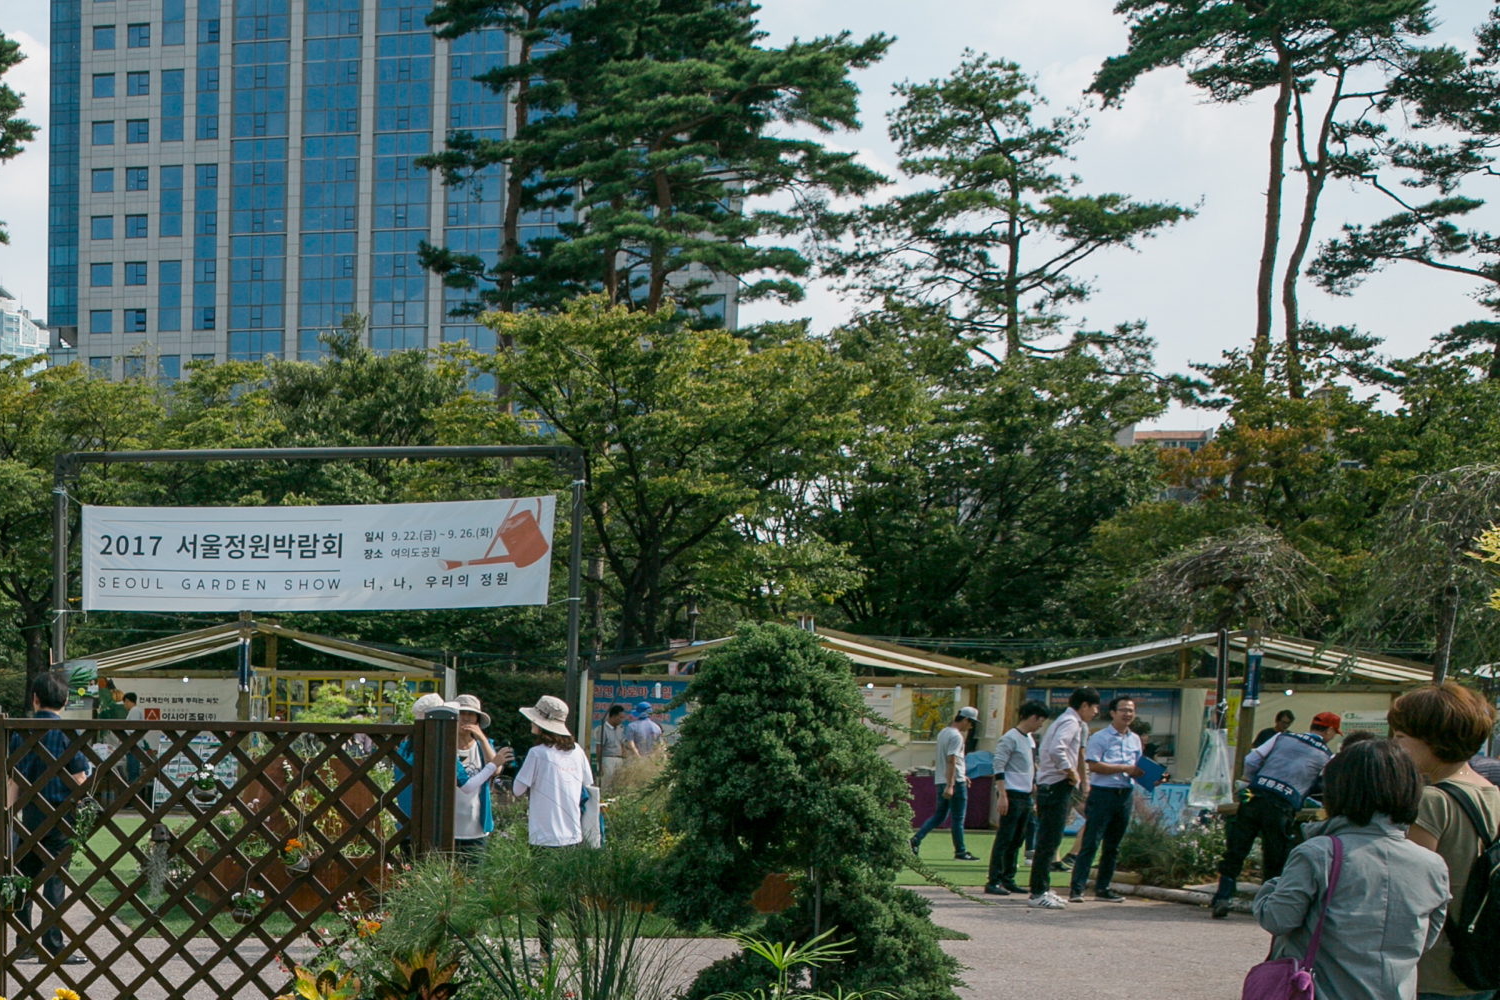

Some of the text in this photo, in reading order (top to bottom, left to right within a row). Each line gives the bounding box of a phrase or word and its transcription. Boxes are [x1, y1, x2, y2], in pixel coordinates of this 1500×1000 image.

[364, 531, 384, 543] 일시
[391, 531, 401, 542] 9.
[403, 529, 437, 542] 22.(금)
[447, 529, 457, 539] 9.
[460, 527, 494, 540] 26.(화)
[100, 532, 344, 560] 2017 서울정원박람회
[363, 546, 441, 560] 장소 여의도공원
[98, 576, 341, 591] SEOUL GARDEN SHOW
[363, 572, 508, 591] 너, 나, 우리의 정원
[616, 685, 648, 699] 아로마
[1257, 777, 1294, 796] 영등포구
